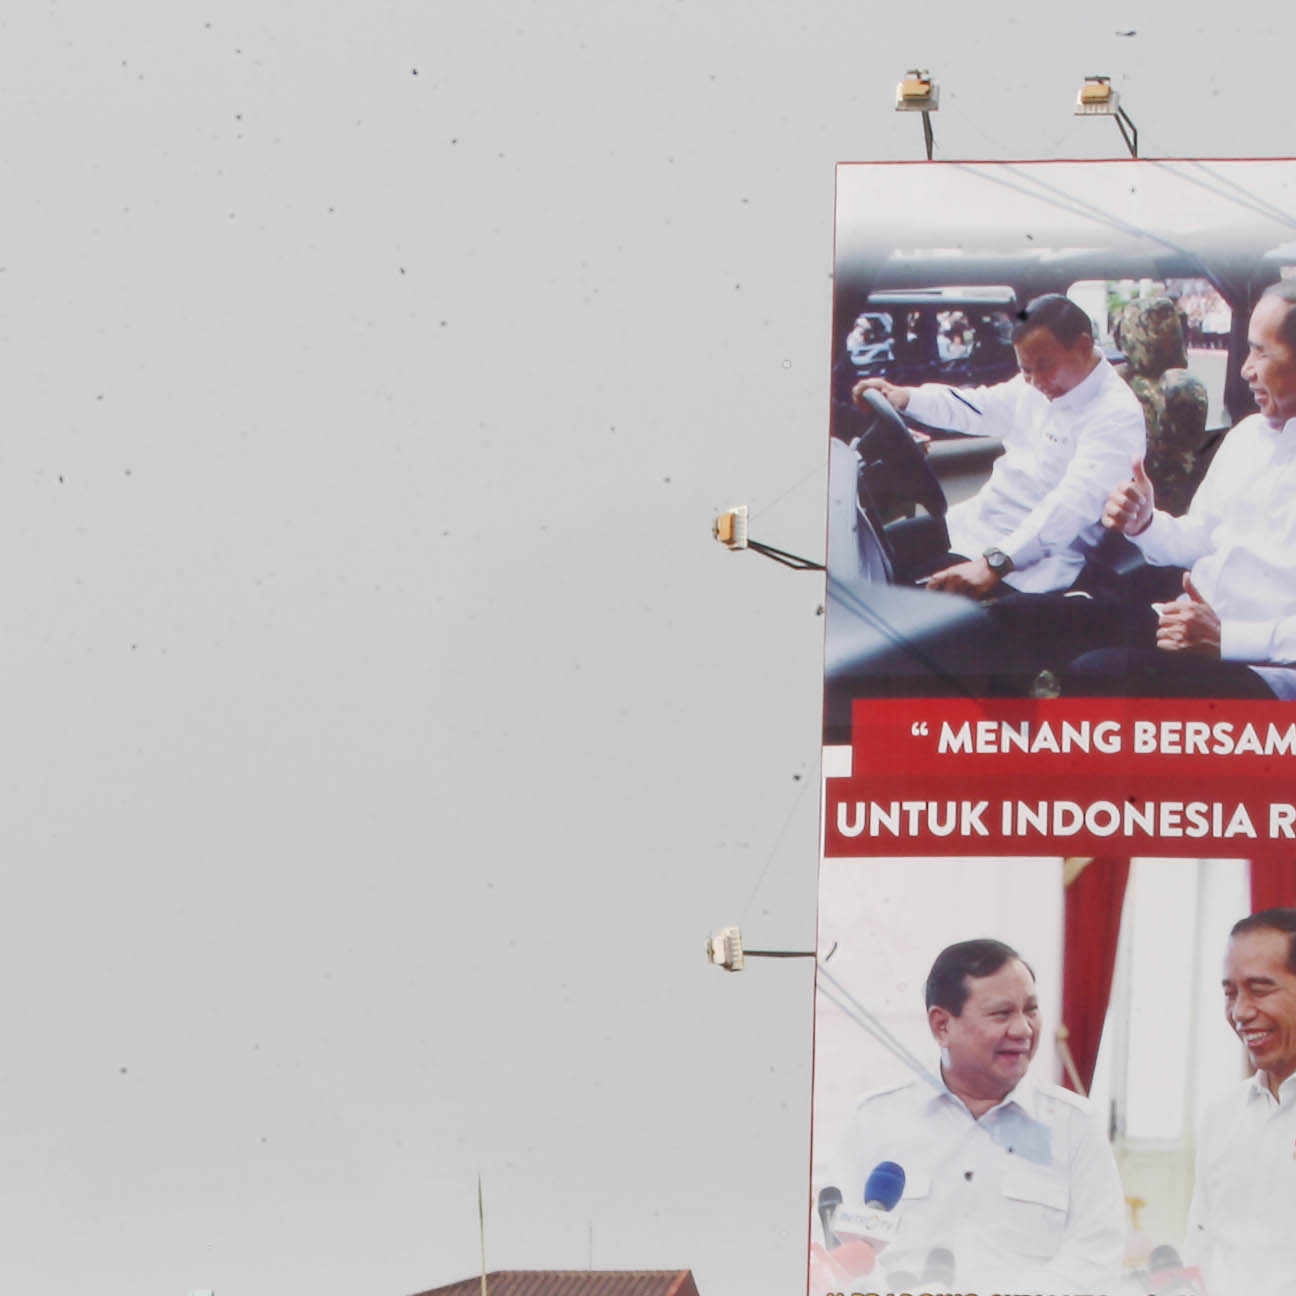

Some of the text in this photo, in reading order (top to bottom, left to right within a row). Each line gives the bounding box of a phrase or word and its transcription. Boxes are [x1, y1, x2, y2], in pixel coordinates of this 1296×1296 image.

[937, 720, 1122, 754] MENANG
[836, 800, 990, 838] UNTUK
[1002, 800, 1258, 838] INDONESIA
